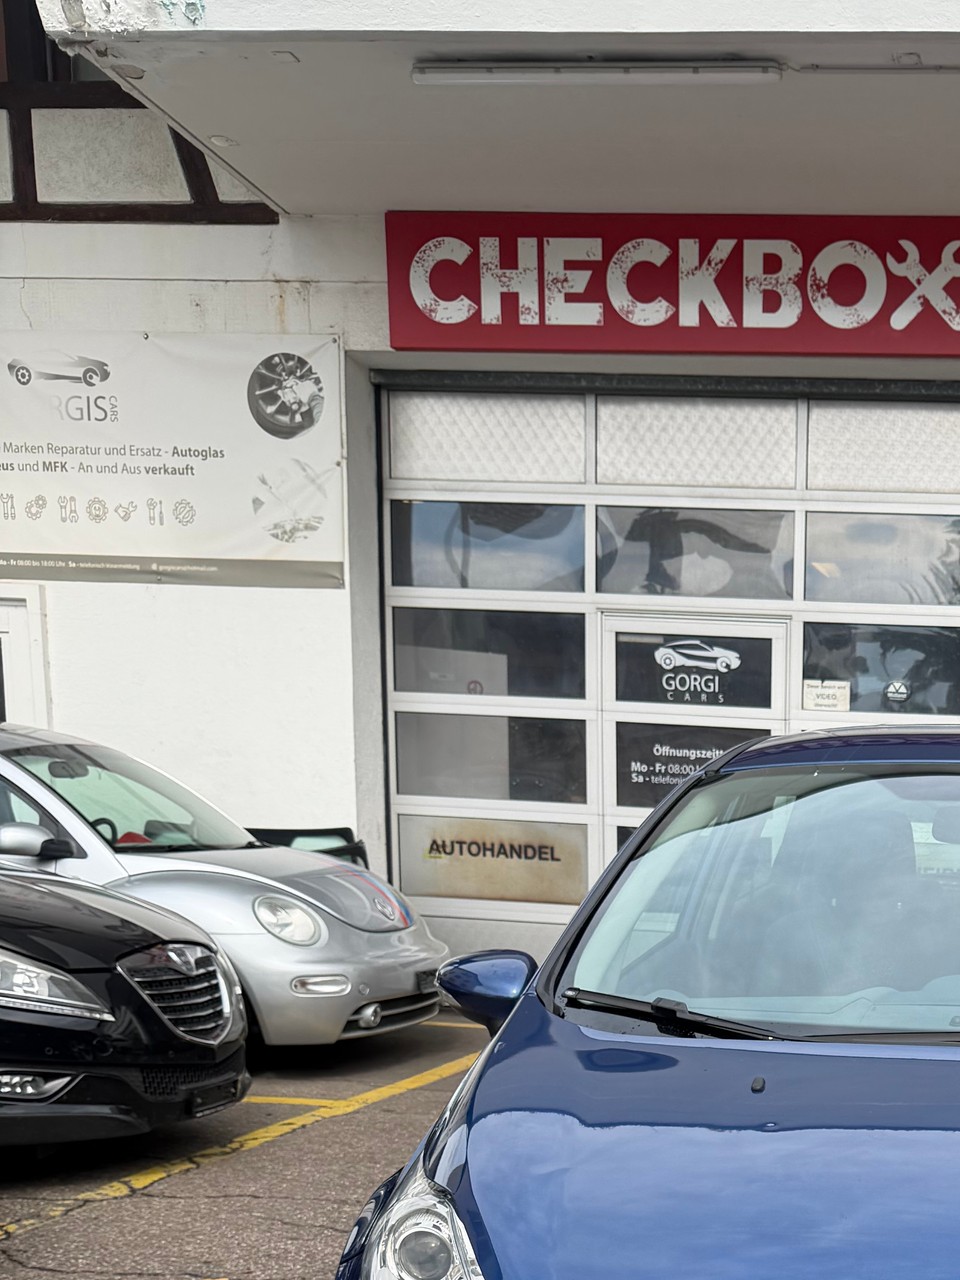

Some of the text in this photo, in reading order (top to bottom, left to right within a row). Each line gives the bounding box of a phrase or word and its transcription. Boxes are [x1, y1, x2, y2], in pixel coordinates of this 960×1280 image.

[108, 395, 119, 422] CARS
[3, 442, 44, 454] Marken
[47, 442, 102, 457] Reparatur
[104, 444, 127, 456] und
[129, 445, 162, 457] Ersatz
[171, 446, 225, 461] Autoglas
[18, 461, 39, 471] und
[42, 461, 69, 473] MFK
[78, 462, 93, 473] An
[96, 463, 118, 474] und
[121, 463, 141, 474] Aus
[144, 464, 195, 476] verkauft
[662, 673, 719, 693] GORGI
[667, 692, 724, 703] CARS
[631, 761, 648, 772] Mo
[655, 763, 666, 773] Fr
[667, 765, 694, 774] 08:00
[631, 773, 644, 783] Sa
[428, 838, 561, 862] AUTOHANDEL
